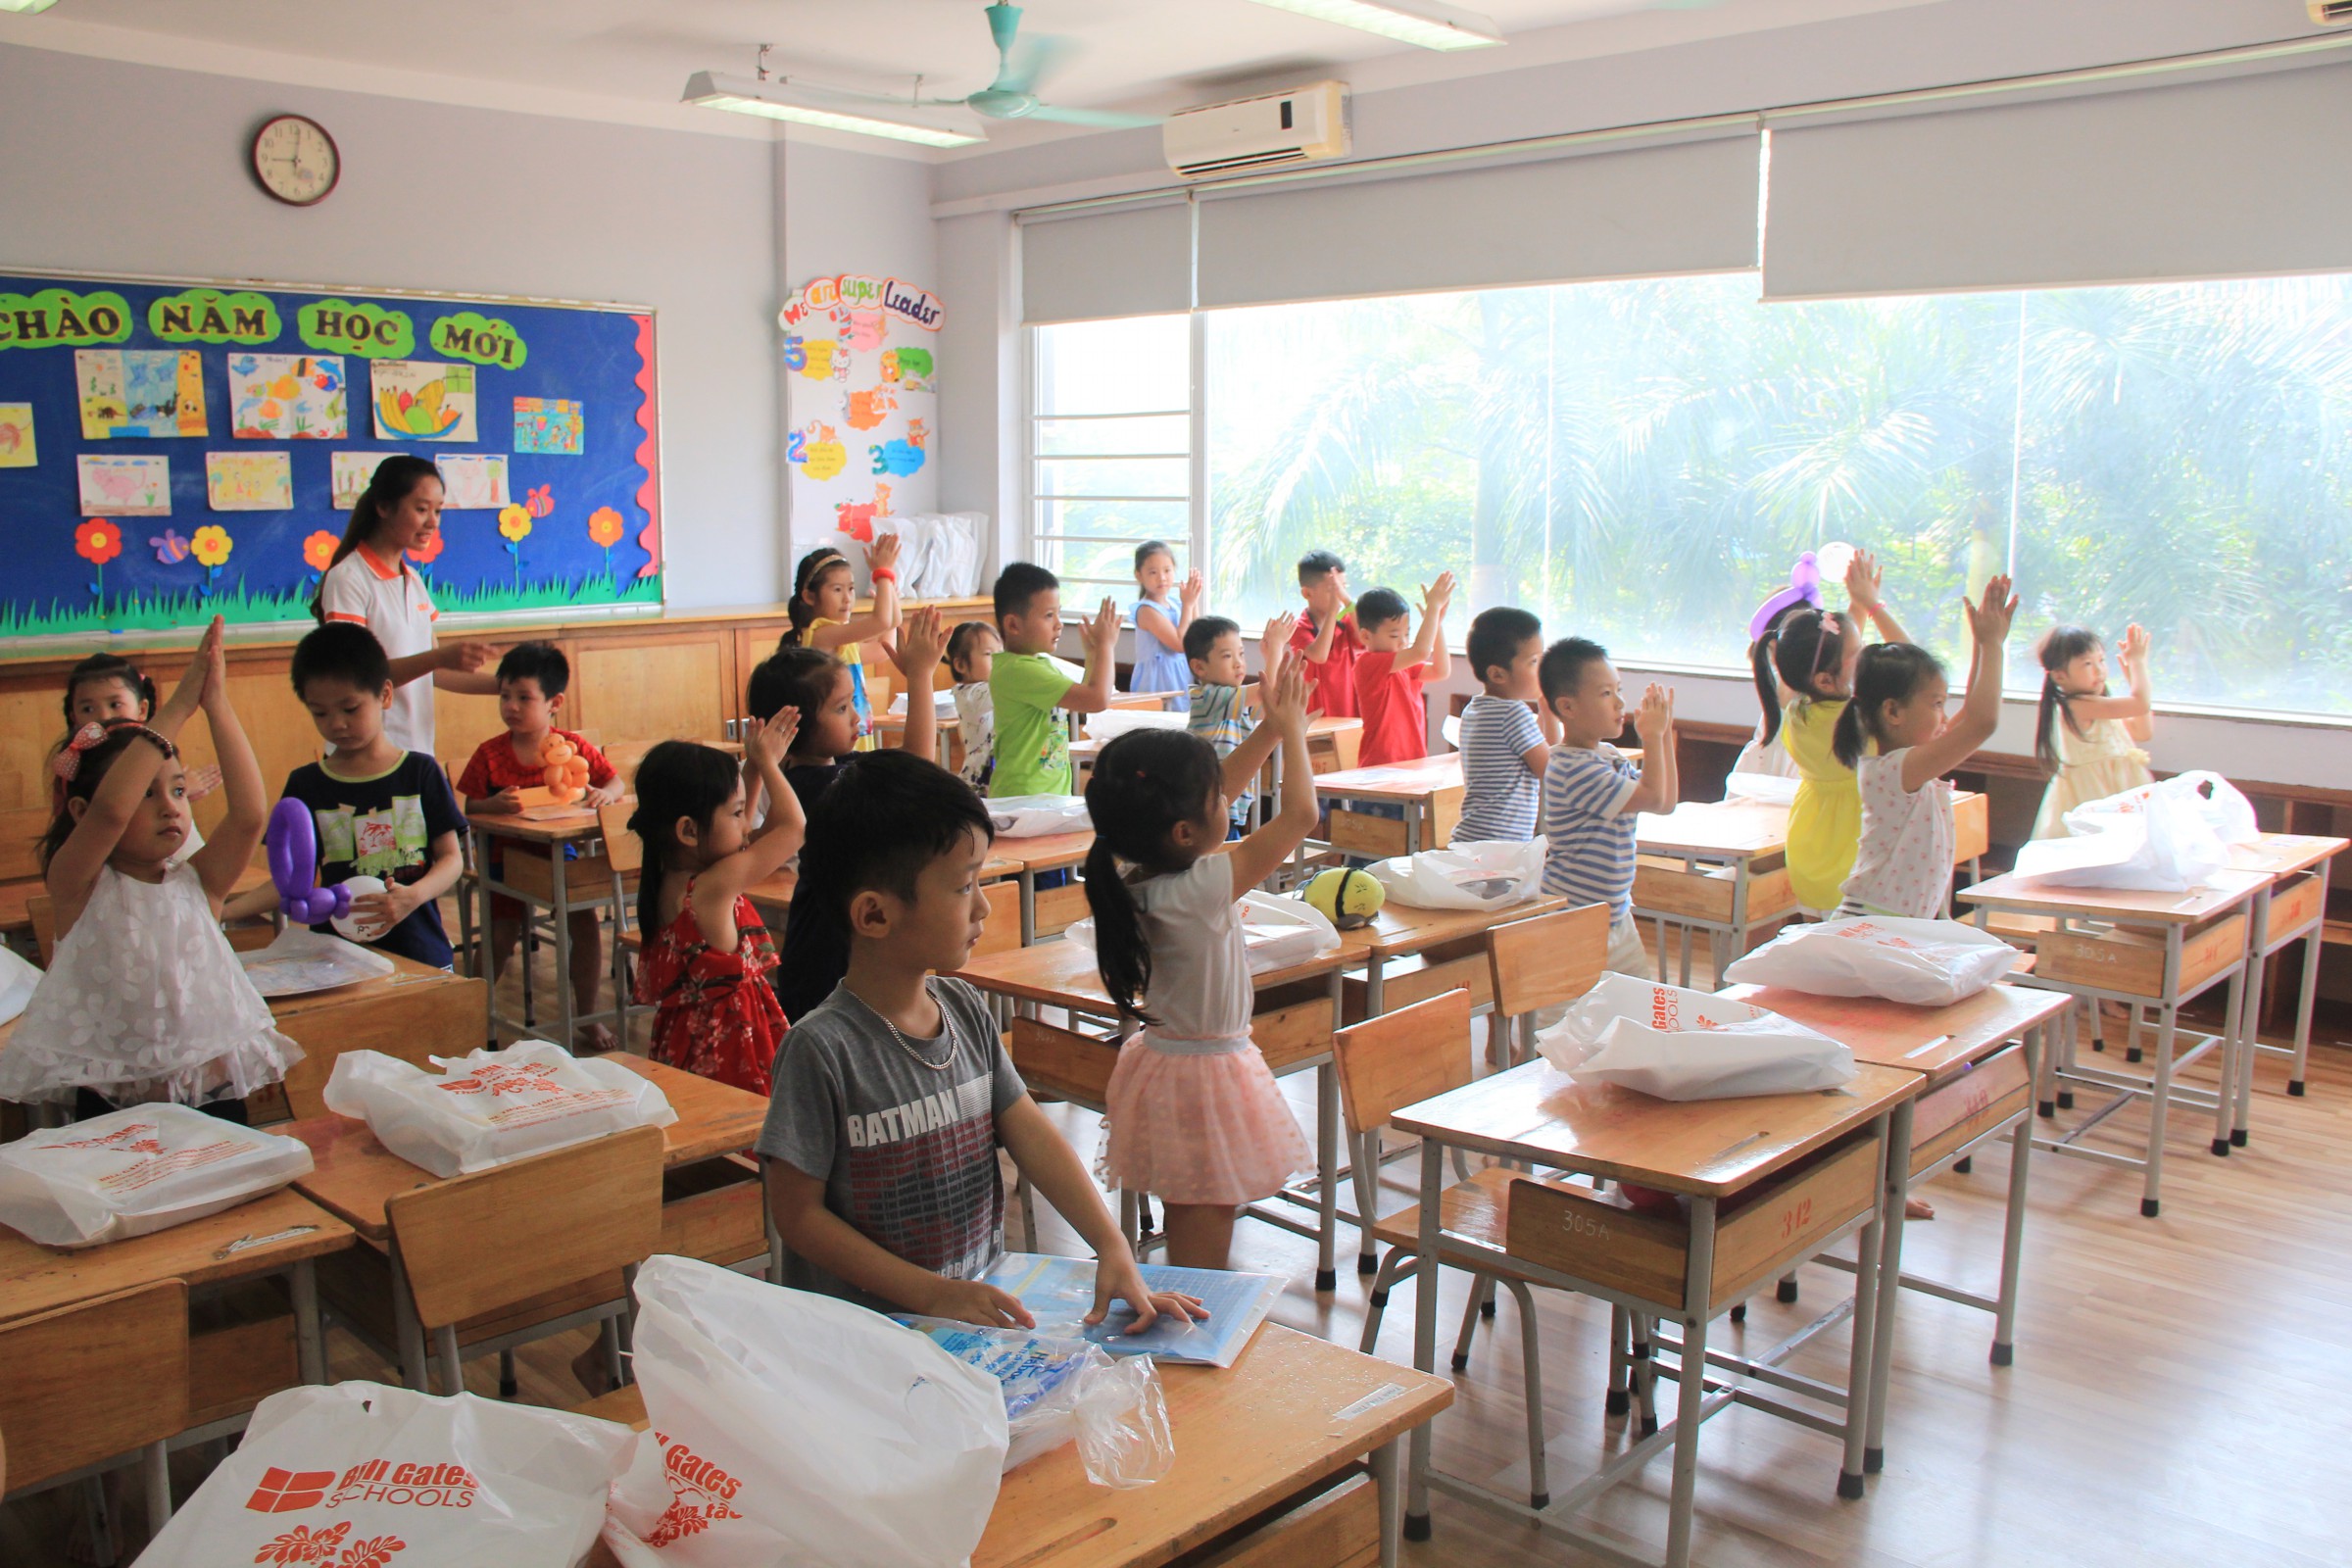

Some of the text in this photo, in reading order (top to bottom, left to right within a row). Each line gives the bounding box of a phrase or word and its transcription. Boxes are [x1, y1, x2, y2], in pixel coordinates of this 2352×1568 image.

[884, 280, 940, 325] Leader
[162, 296, 268, 337] NĂM
[315, 309, 399, 350] HỌC
[443, 322, 514, 364] MỚI
[783, 335, 808, 371] 5
[786, 428, 808, 464] 2
[868, 444, 889, 475] 3
[1652, 987, 1666, 1030] Gates
[1668, 989, 1679, 1030] OOLS
[847, 1089, 959, 1148] BATMAN
[1562, 1208, 1610, 1241] 305A
[336, 1458, 480, 1492] Bill Gates
[665, 1444, 743, 1499] Gates
[324, 1483, 475, 1509] SCHOOLS
